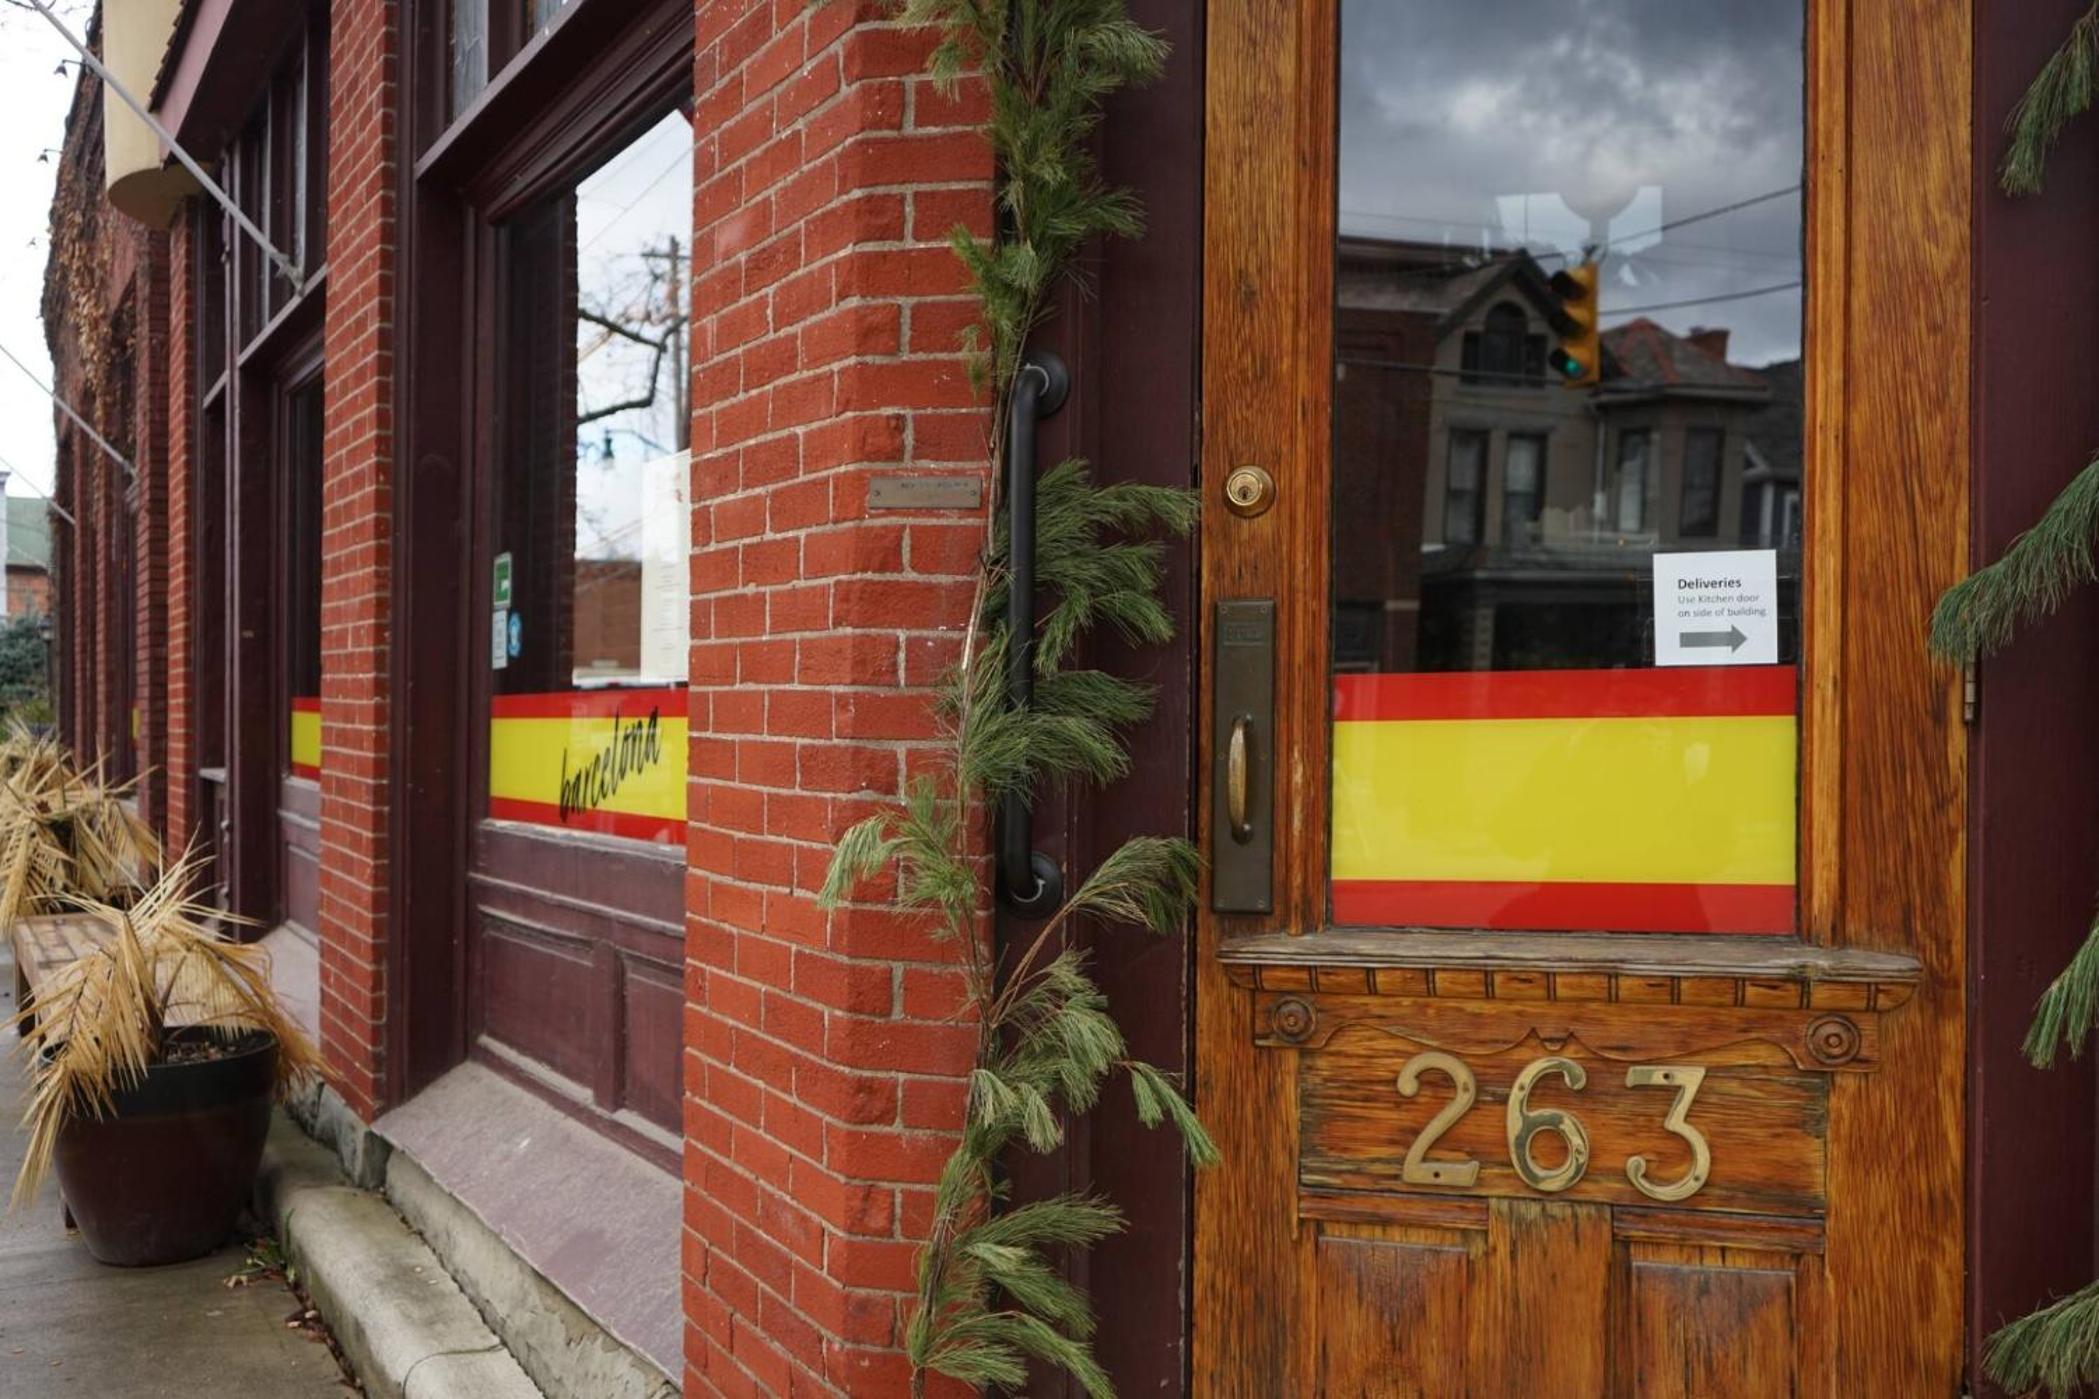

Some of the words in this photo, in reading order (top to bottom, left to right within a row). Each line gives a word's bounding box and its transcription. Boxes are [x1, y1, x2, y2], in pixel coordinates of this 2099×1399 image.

[1678, 577, 1741, 590] Deliveries
[1678, 594, 1696, 605] Use
[1698, 593, 1734, 604] Kitchen
[1736, 593, 1760, 603] door
[1678, 609, 1691, 618] on
[1693, 607, 1713, 617] side
[1715, 607, 1726, 617] of
[560, 705, 660, 822] barcelona
[1397, 1051, 1711, 1201] 263
